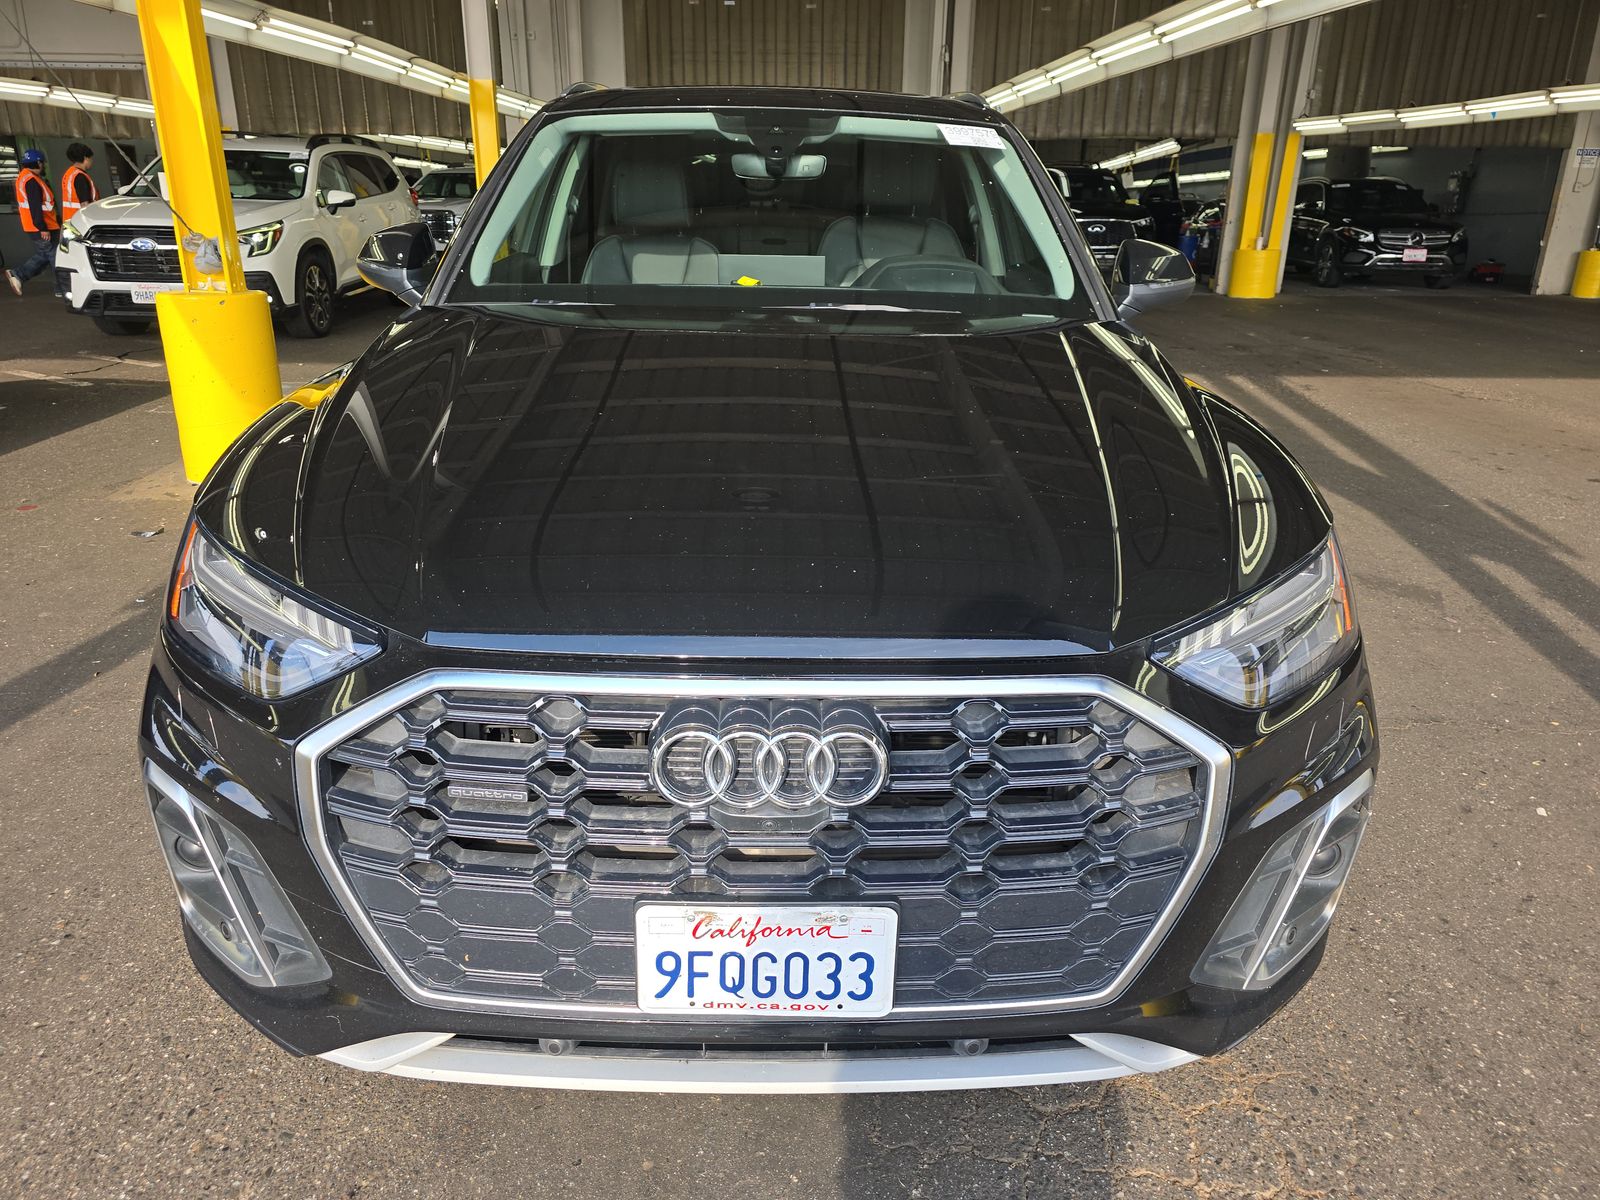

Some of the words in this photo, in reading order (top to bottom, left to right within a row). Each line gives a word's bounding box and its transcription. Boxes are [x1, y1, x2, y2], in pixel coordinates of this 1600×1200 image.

[450, 788, 523, 799] quattro
[691, 916, 848, 947] California
[654, 951, 875, 1000] 9FQG033
[702, 1000, 829, 1011] dmv.ca.gov
